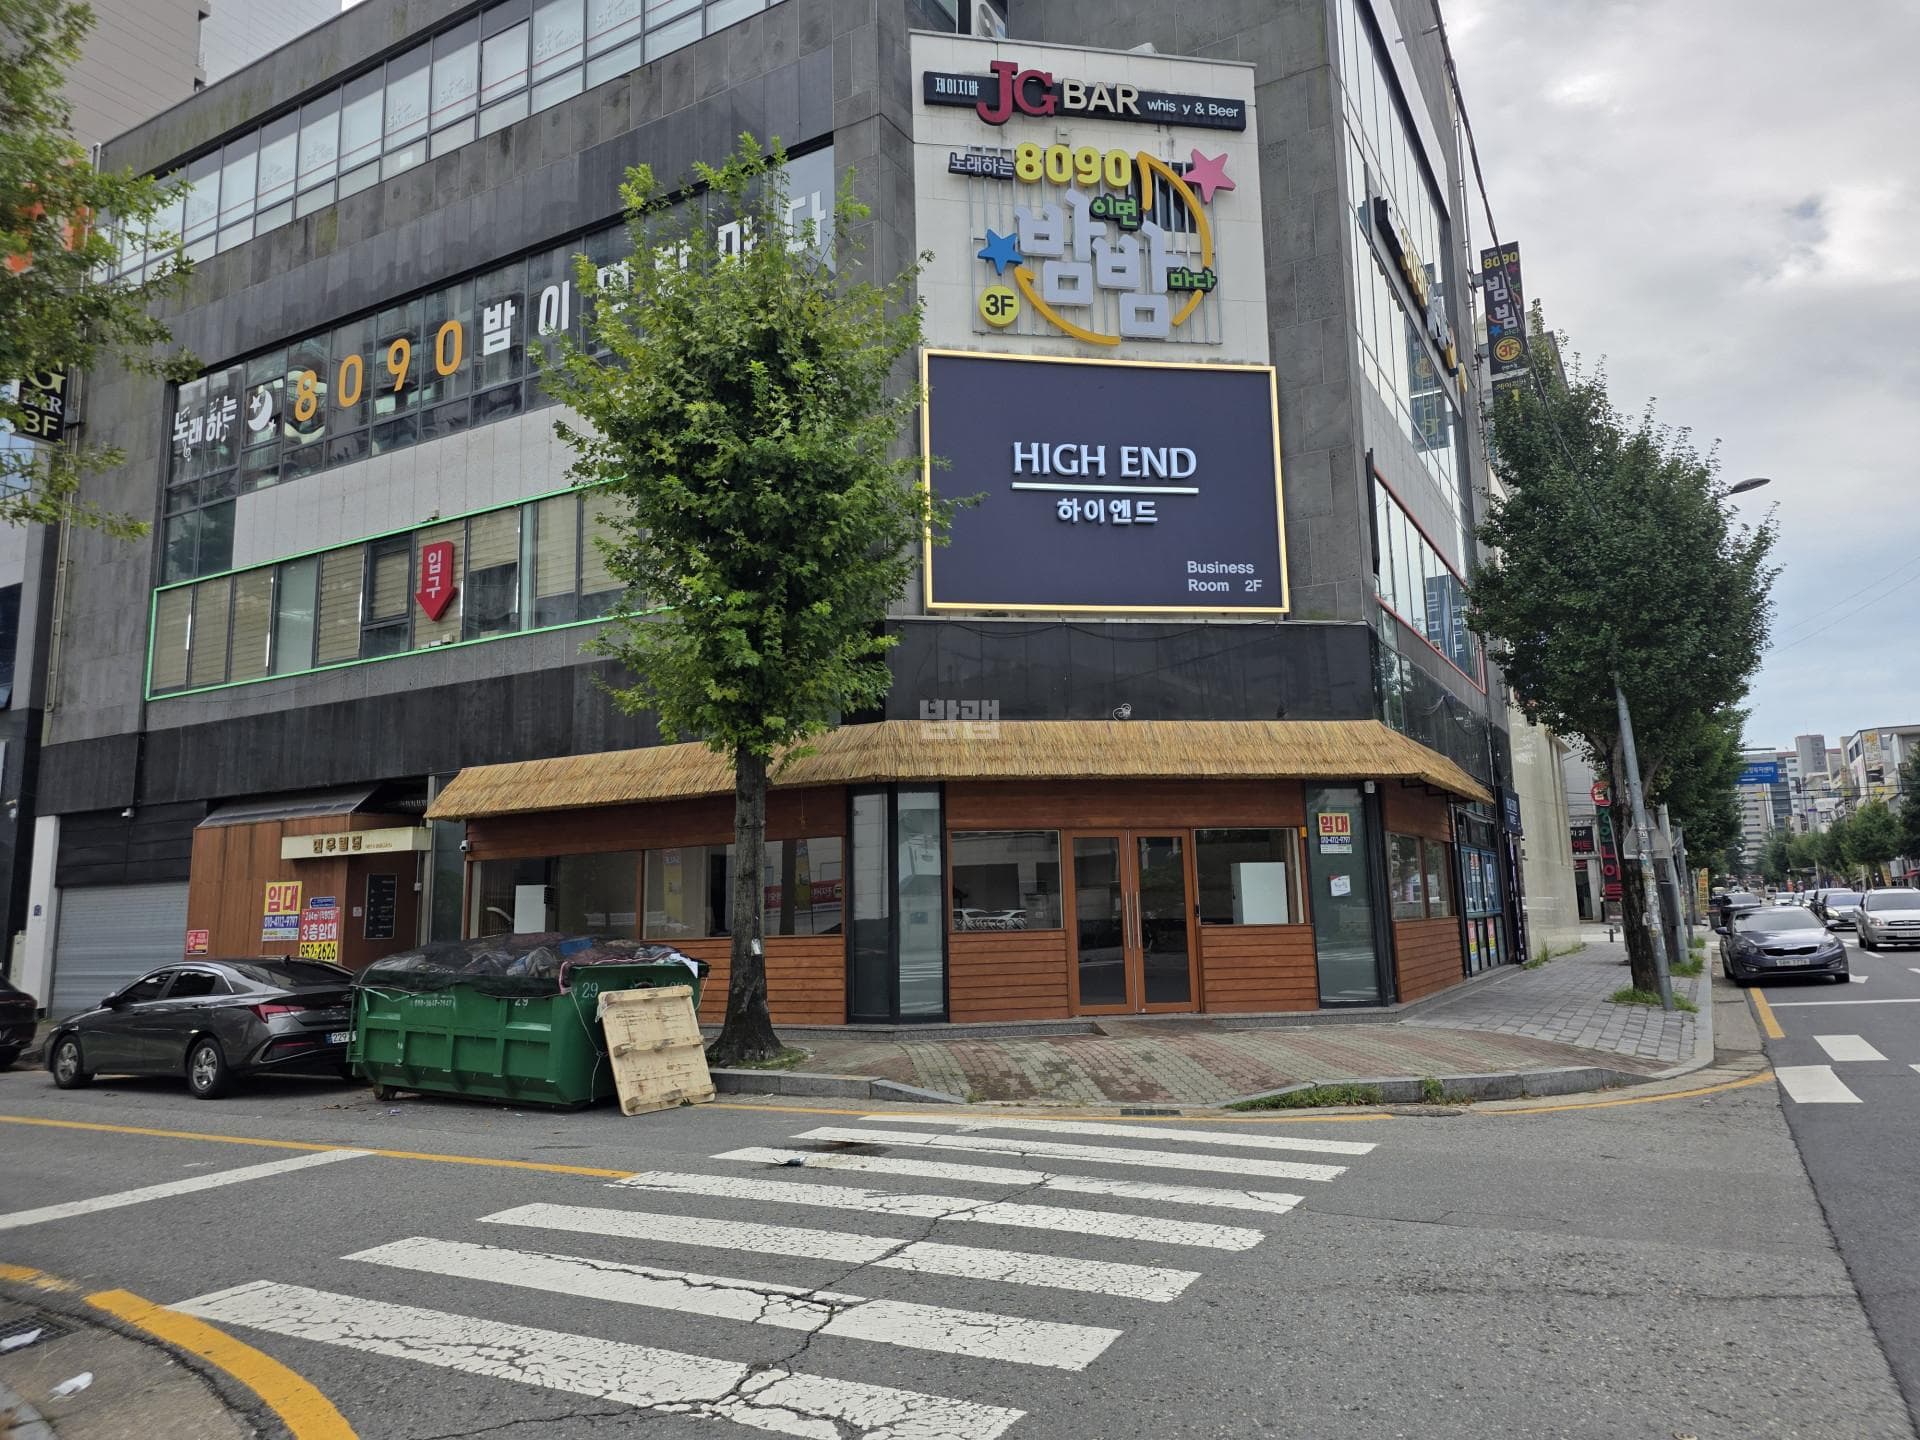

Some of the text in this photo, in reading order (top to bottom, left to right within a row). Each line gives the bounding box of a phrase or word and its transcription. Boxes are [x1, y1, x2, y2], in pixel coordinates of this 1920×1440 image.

[935, 77, 979, 97] 제이지바
[976, 60, 1141, 126] JG BAR
[1195, 103, 1205, 115] &
[1208, 104, 1239, 118] Beer
[950, 142, 1132, 188] 노래하는 8090
[985, 295, 1015, 316] 3F
[294, 320, 463, 421] 8090
[24, 410, 58, 436] 3F
[1013, 441, 1198, 479] HIGH END
[1057, 497, 1158, 525] 하이엔드
[426, 549, 442, 599] 입구
[1187, 561, 1255, 575] Business
[1188, 579, 1262, 593] Room 2F
[1321, 815, 1349, 833] 임대
[268, 886, 299, 912] 임대
